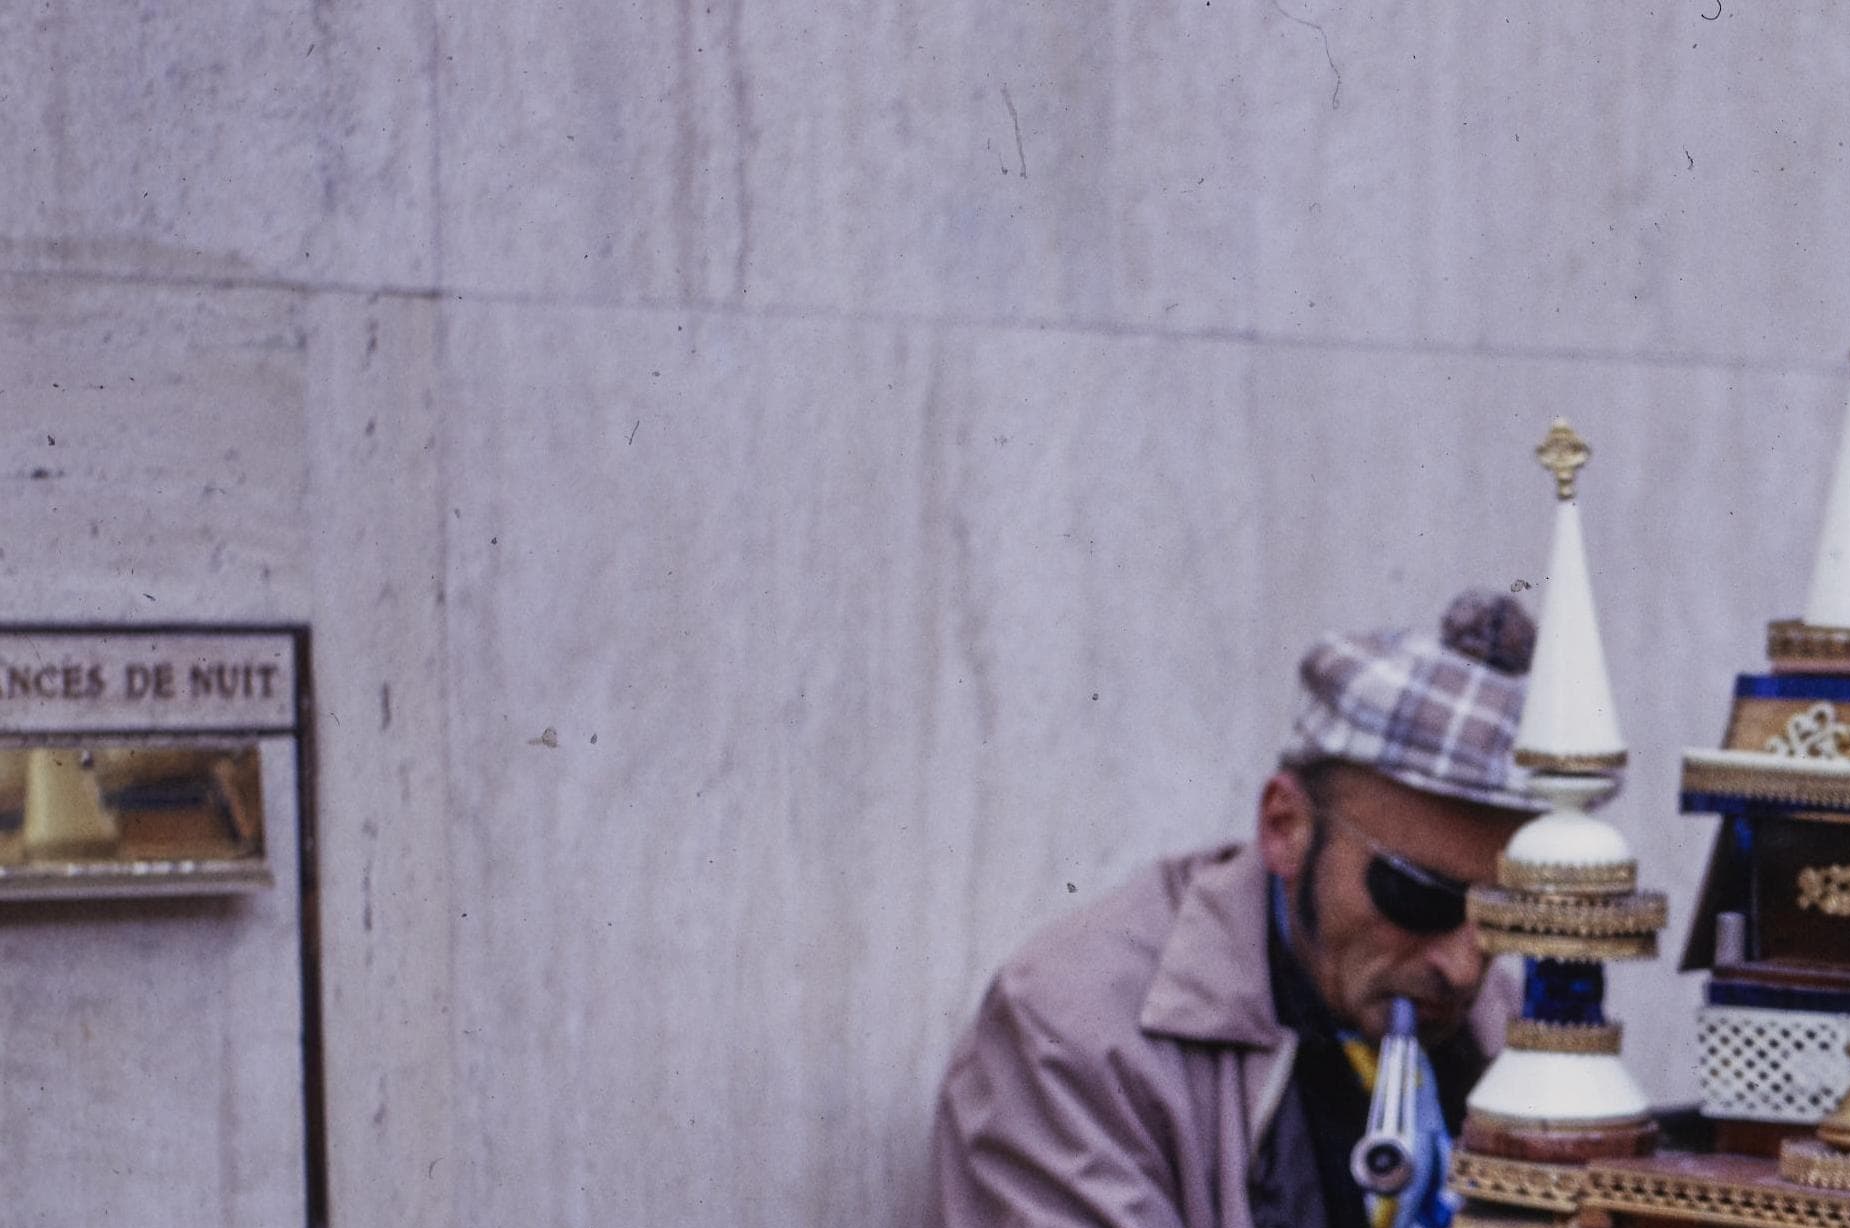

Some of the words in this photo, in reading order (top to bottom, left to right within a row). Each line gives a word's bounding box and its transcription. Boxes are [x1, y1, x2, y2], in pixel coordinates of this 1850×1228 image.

[0, 664, 105, 699] NCES
[124, 663, 177, 699] DE
[189, 662, 278, 699] NUIT
